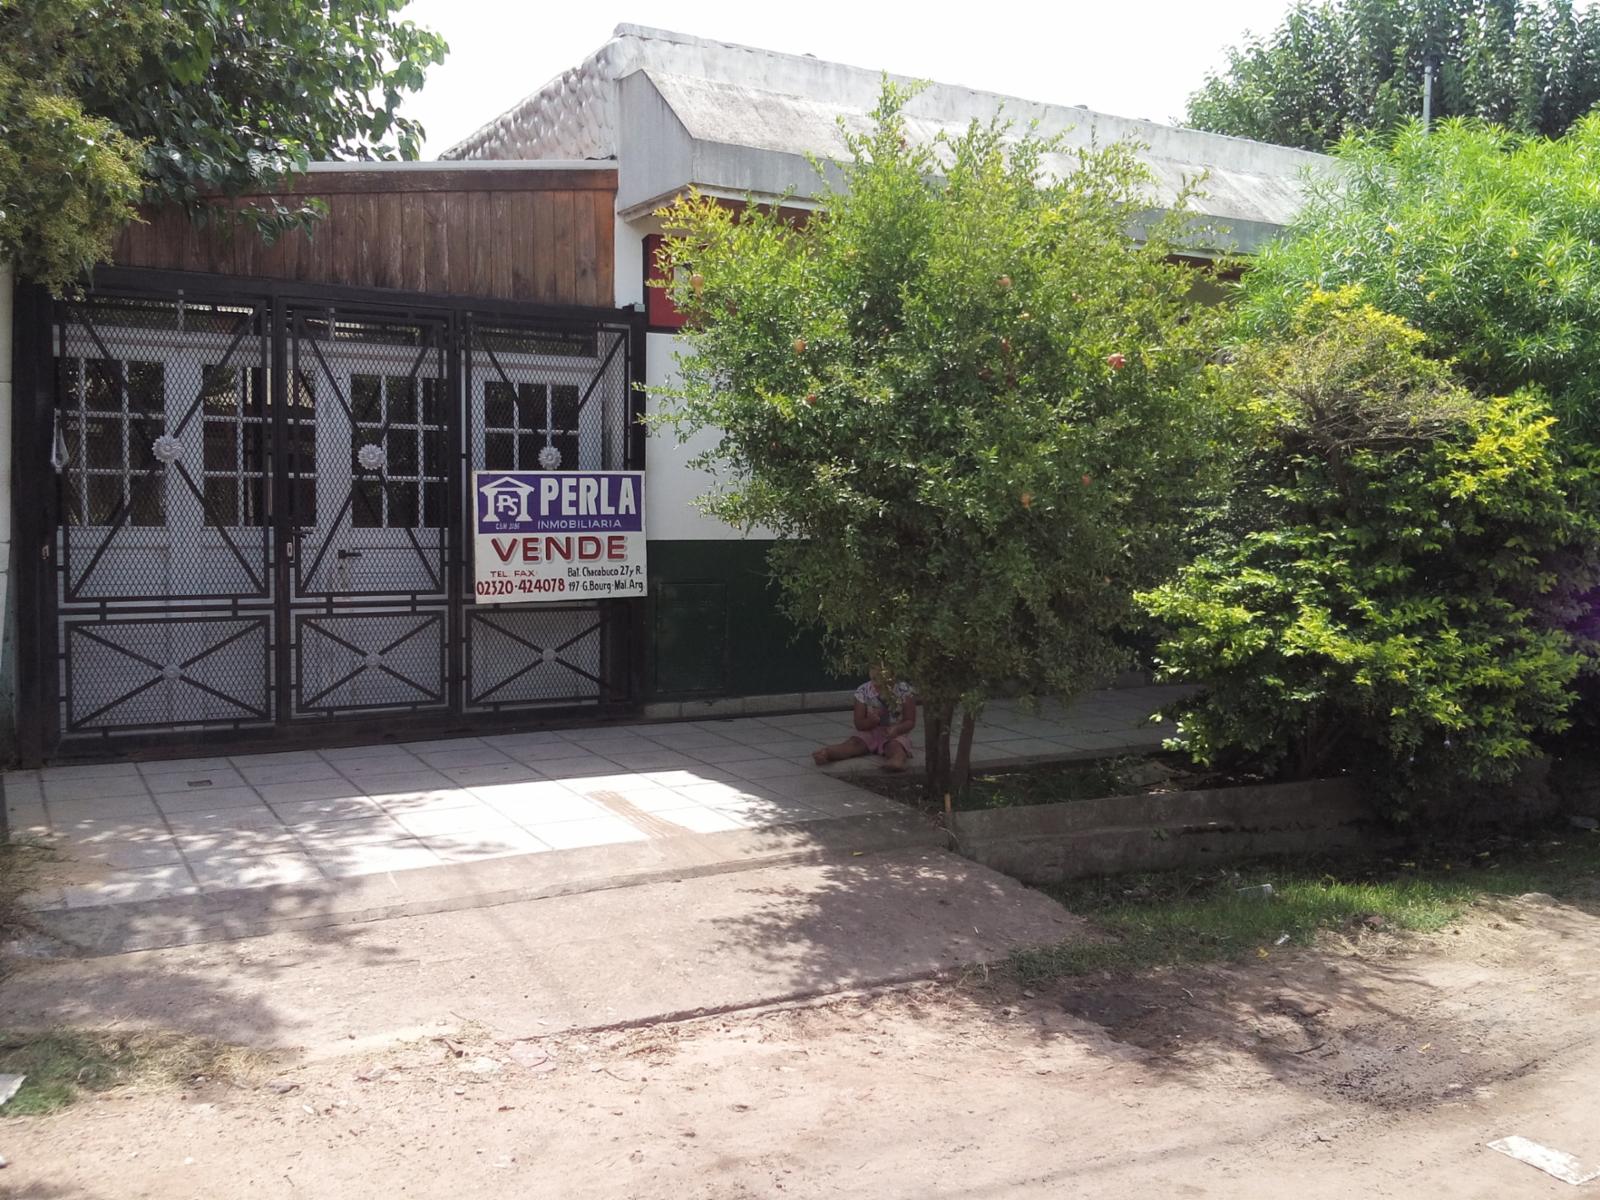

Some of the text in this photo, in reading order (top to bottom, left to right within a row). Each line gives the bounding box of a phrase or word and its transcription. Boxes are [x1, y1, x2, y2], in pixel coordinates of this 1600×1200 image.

[540, 477, 637, 516] PERLA
[537, 519, 622, 529] INMOBILIARIA
[490, 535, 628, 563] VENDE
